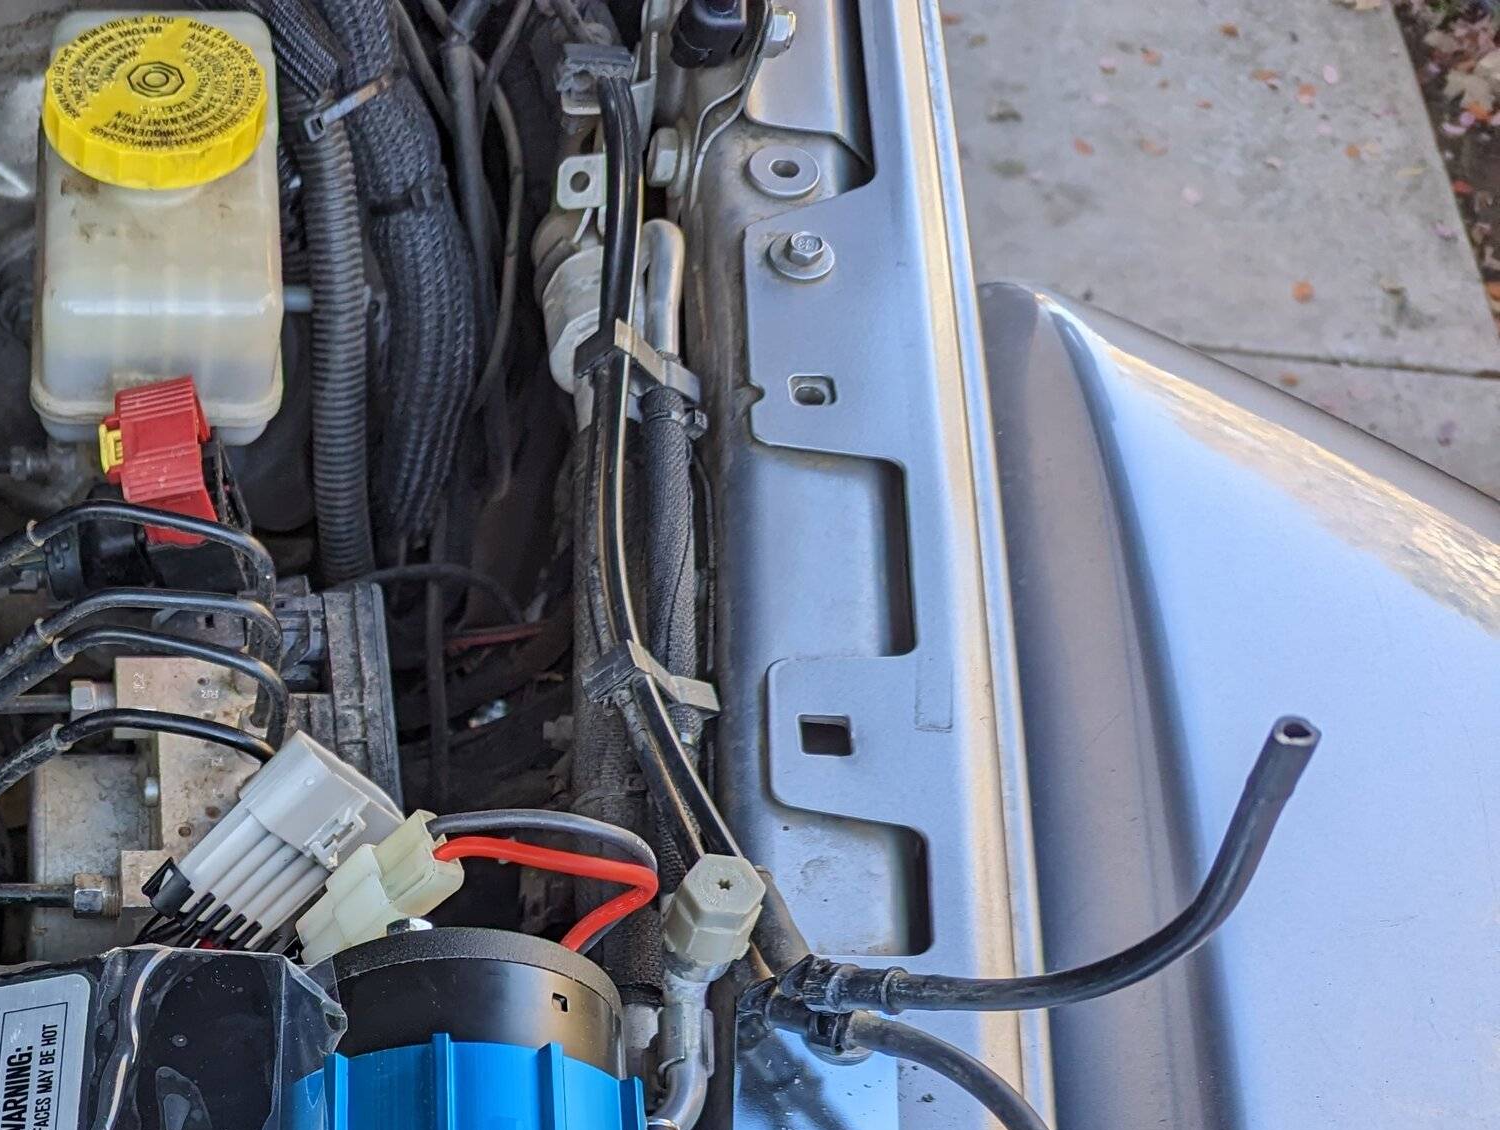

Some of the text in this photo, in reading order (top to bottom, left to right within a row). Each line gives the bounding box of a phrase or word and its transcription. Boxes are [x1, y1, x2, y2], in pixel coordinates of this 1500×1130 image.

[188, 21, 214, 34] MISE
[213, 31, 228, 42] EN
[189, 32, 222, 50] AVANT
[148, 103, 215, 125] PROVENANT
[91, 126, 173, 147] REMPLISSAGE
[104, 121, 183, 137] UNIQUEMENT
[41, 1023, 59, 1046] HOT
[41, 1047, 57, 1067] BE
[38, 1069, 54, 1095] MAY
